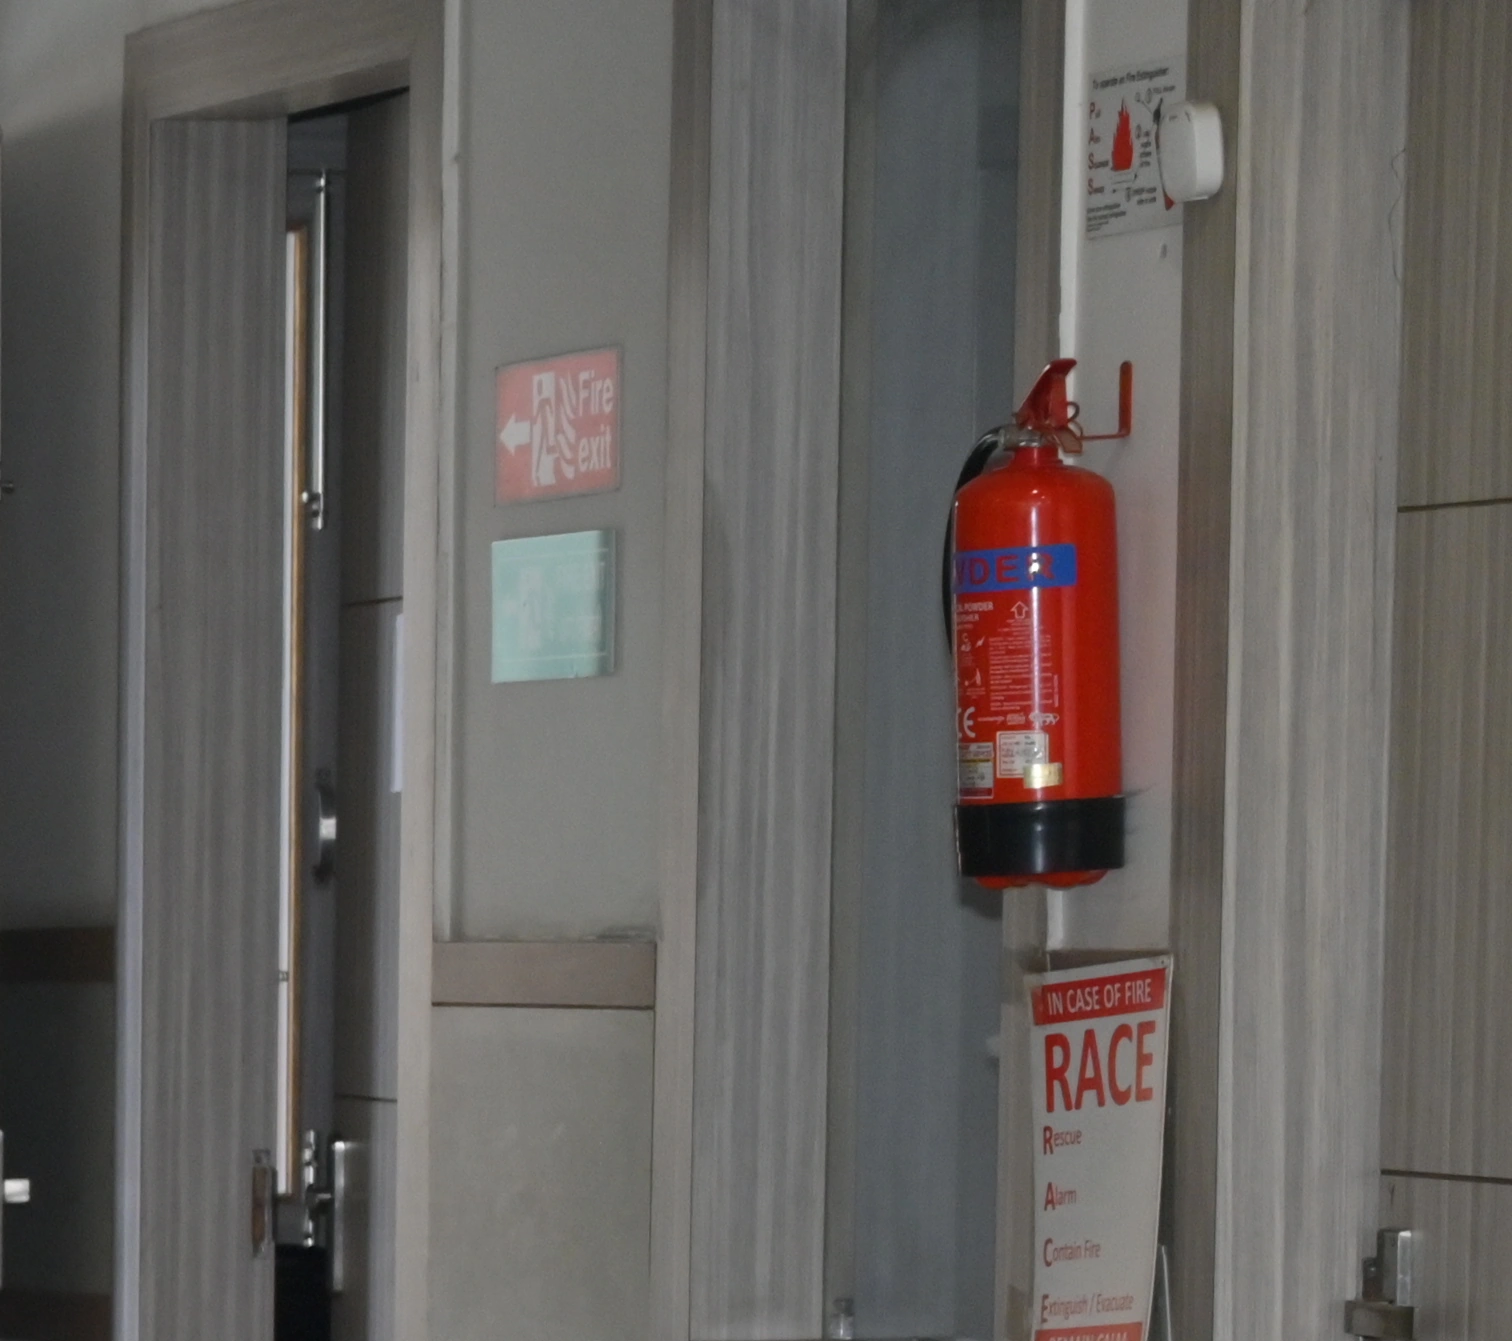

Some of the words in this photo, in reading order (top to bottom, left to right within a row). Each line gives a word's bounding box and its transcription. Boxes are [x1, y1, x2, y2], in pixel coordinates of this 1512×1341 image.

[578, 369, 614, 418] Fire
[578, 423, 613, 473] exit
[1048, 992, 1063, 1015] IN
[1067, 986, 1100, 1013] CASE
[1104, 983, 1121, 1008] OF
[1125, 978, 1152, 1005] FIRE
[1045, 1020, 1156, 1113] RACE
[1044, 1126, 1082, 1155] Rescue
[1044, 1182, 1077, 1211] Alarm
[1044, 1238, 1082, 1267] Contain
[1084, 1240, 1101, 1258] Fire
[1041, 1293, 1088, 1324] Extinguish
[1096, 1293, 1134, 1313] Evacuate
